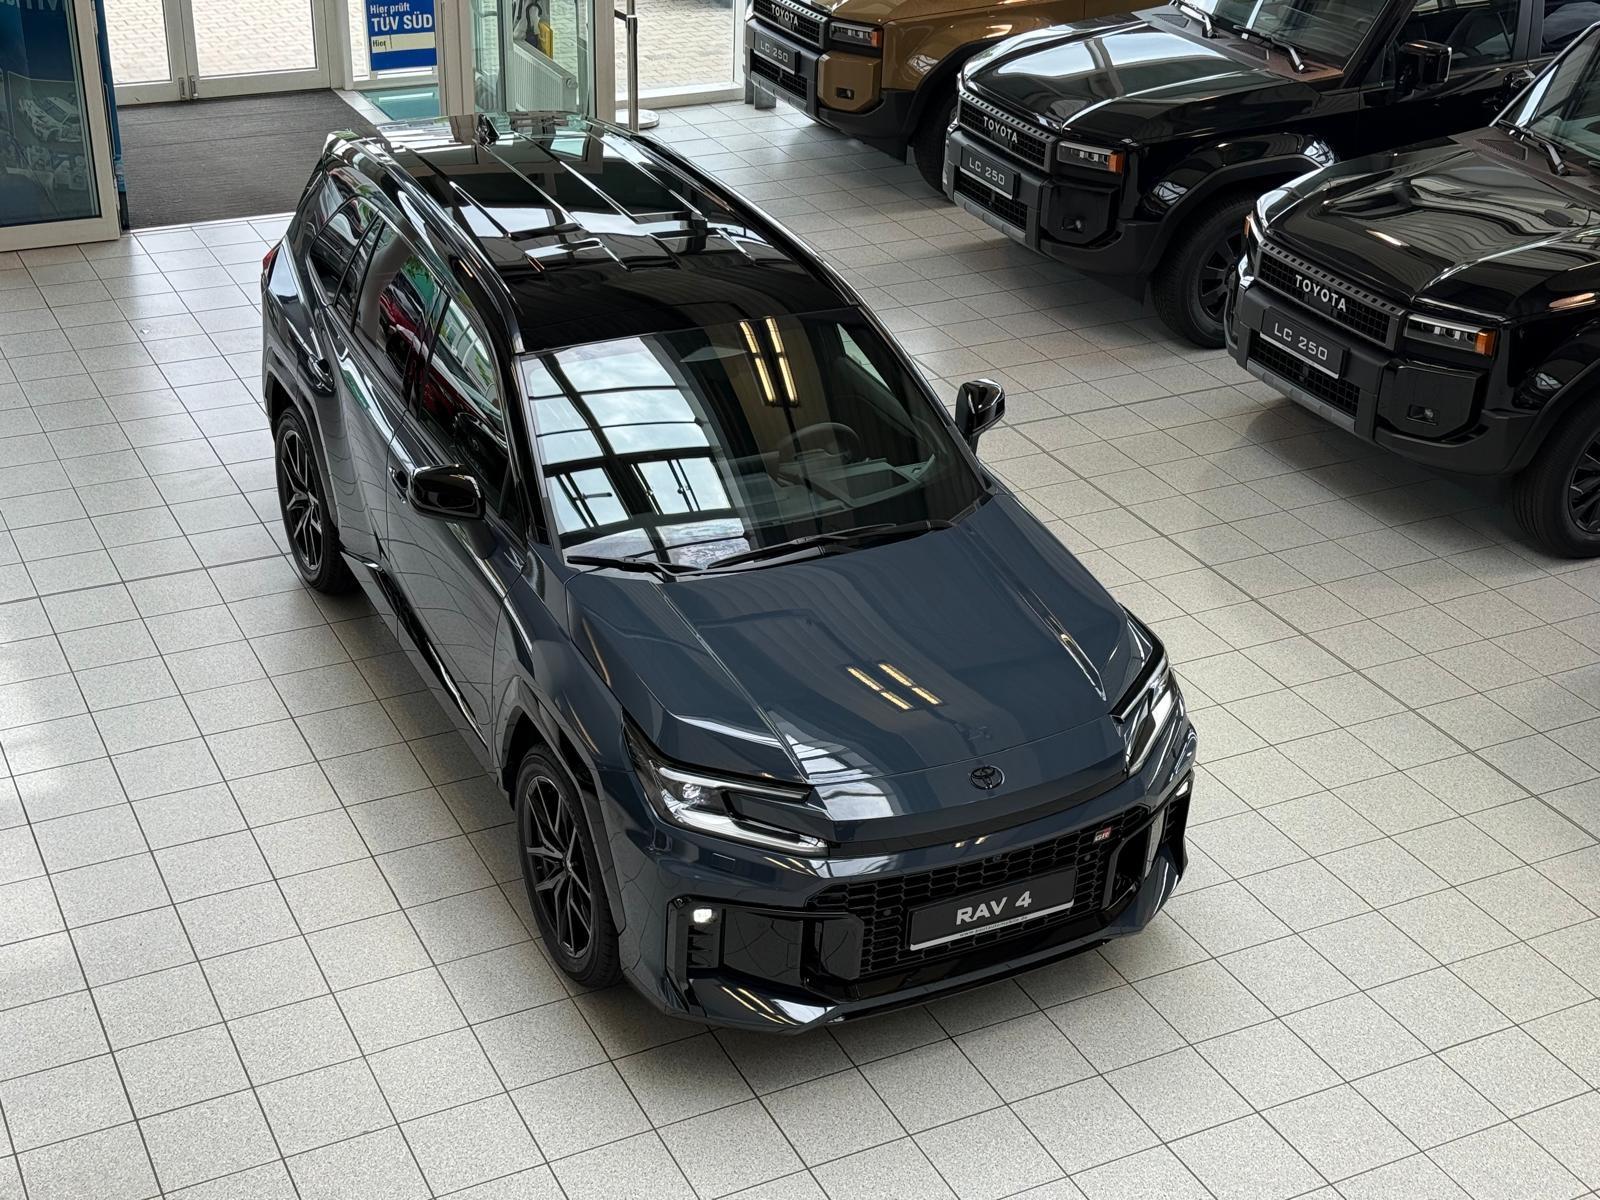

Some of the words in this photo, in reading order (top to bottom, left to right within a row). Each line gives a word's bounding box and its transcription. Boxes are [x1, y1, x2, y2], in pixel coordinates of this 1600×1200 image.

[370, 4, 388, 14] Hier
[390, 2, 411, 15] prüft
[371, 13, 399, 32] TÜV
[403, 11, 433, 30] SÜD
[771, 4, 798, 26] TOYOTA
[760, 40, 770, 53] LC
[772, 47, 788, 62] 250
[983, 116, 1018, 143] TOYOTA
[969, 157, 981, 172] LC
[985, 166, 1005, 185] 250
[1295, 274, 1346, 312] TOYOTA
[1274, 322, 1292, 342] LC
[1298, 336, 1328, 360] 250
[956, 896, 1008, 925] RAV
[1015, 890, 1032, 908] 4
